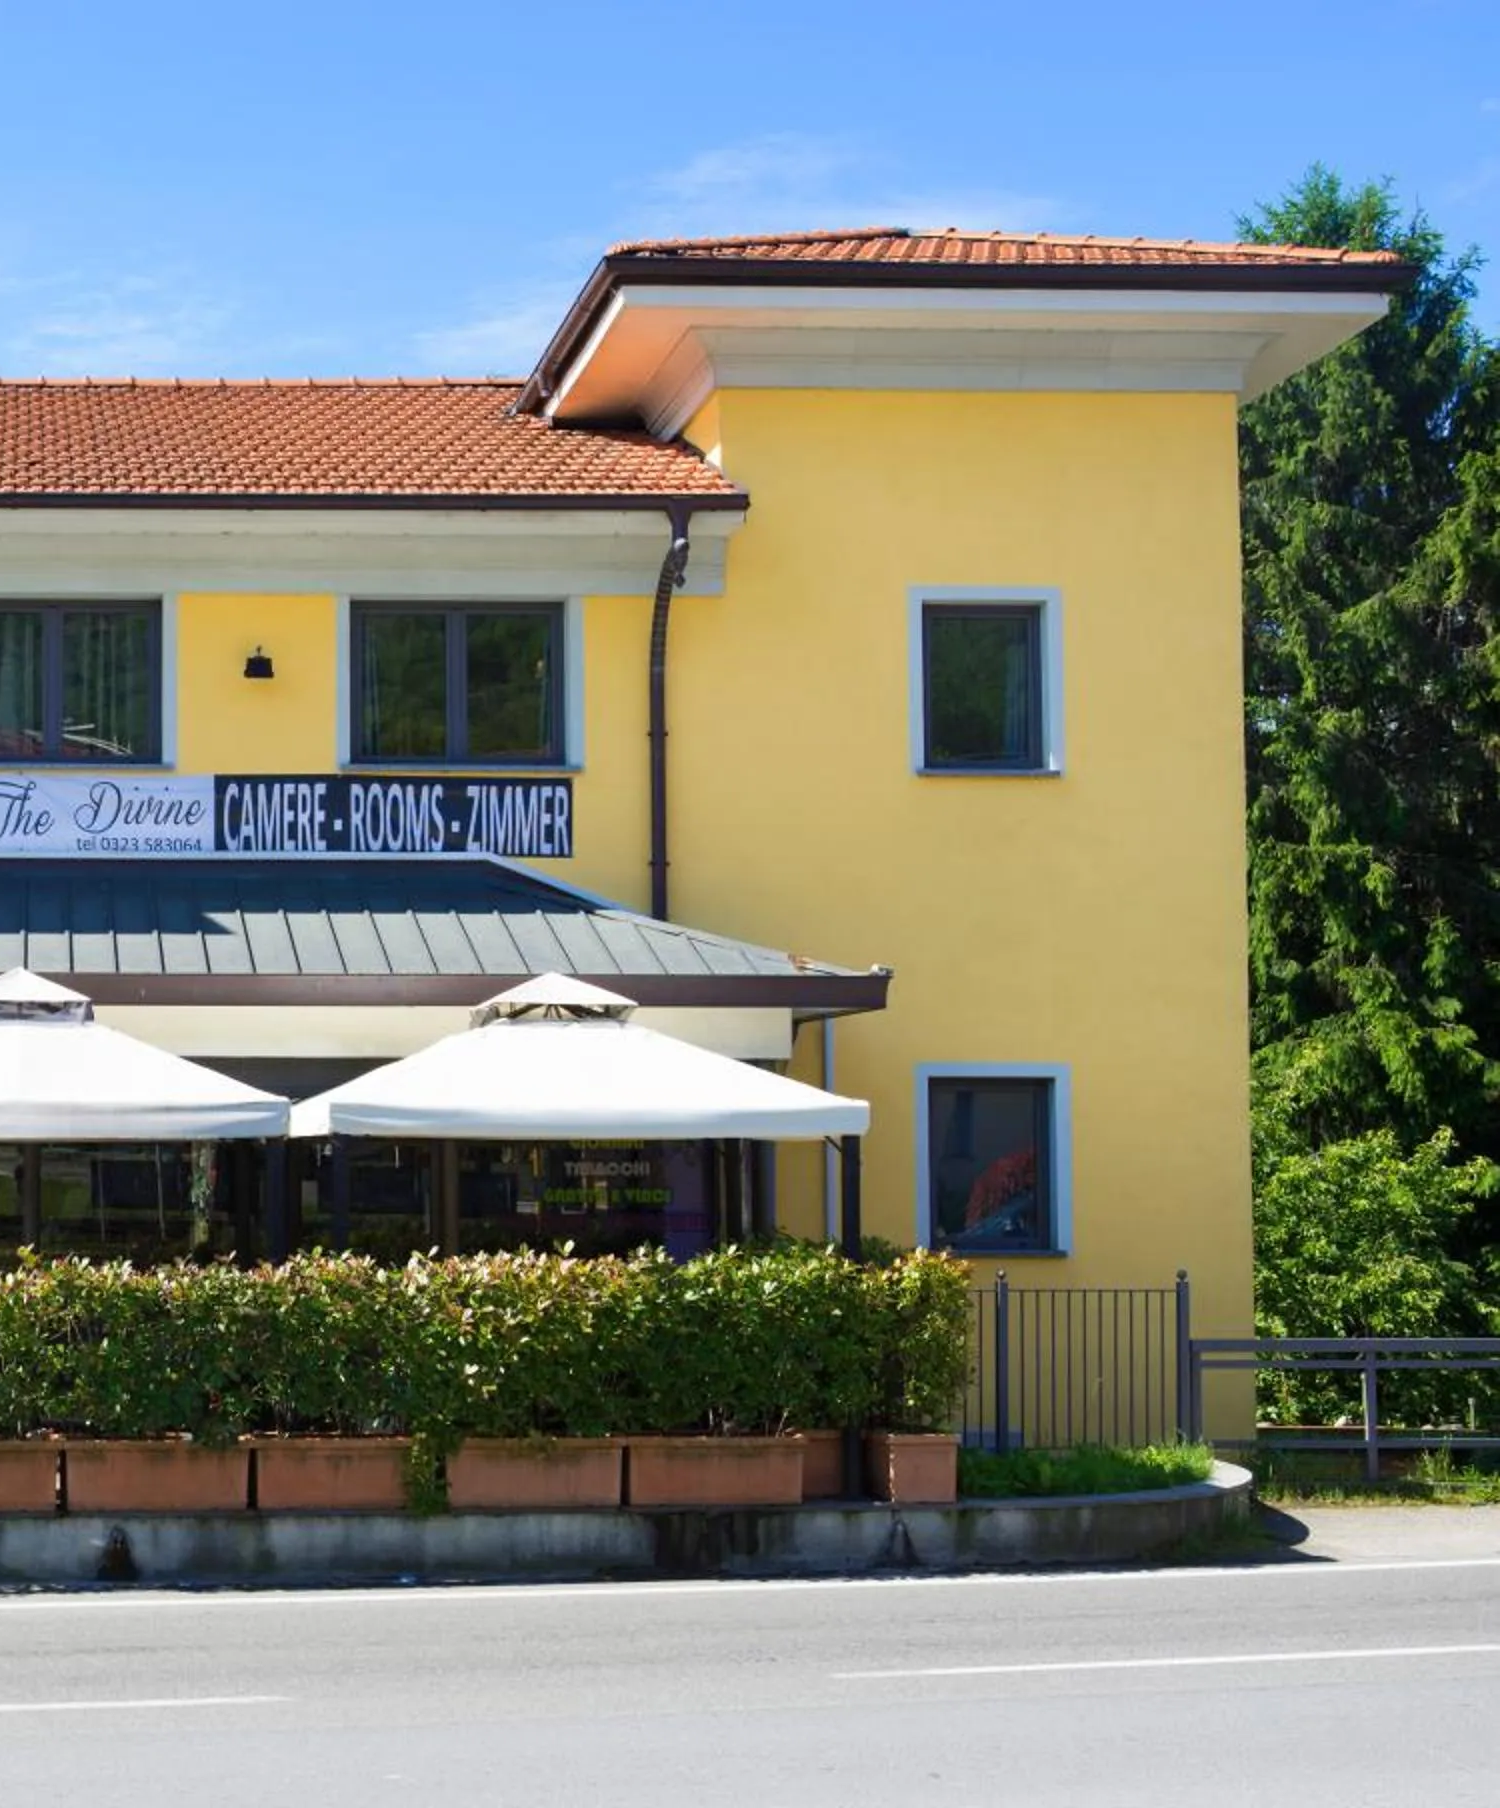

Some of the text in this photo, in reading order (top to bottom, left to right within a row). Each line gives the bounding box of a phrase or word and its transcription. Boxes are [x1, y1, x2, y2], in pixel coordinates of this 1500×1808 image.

[74, 781, 206, 834] Divine
[223, 782, 327, 853] CAMERE
[350, 783, 445, 852] ROOMS
[466, 785, 569, 856] ZIMMER
[101, 837, 139, 850] 0323
[144, 838, 203, 852] 583064
